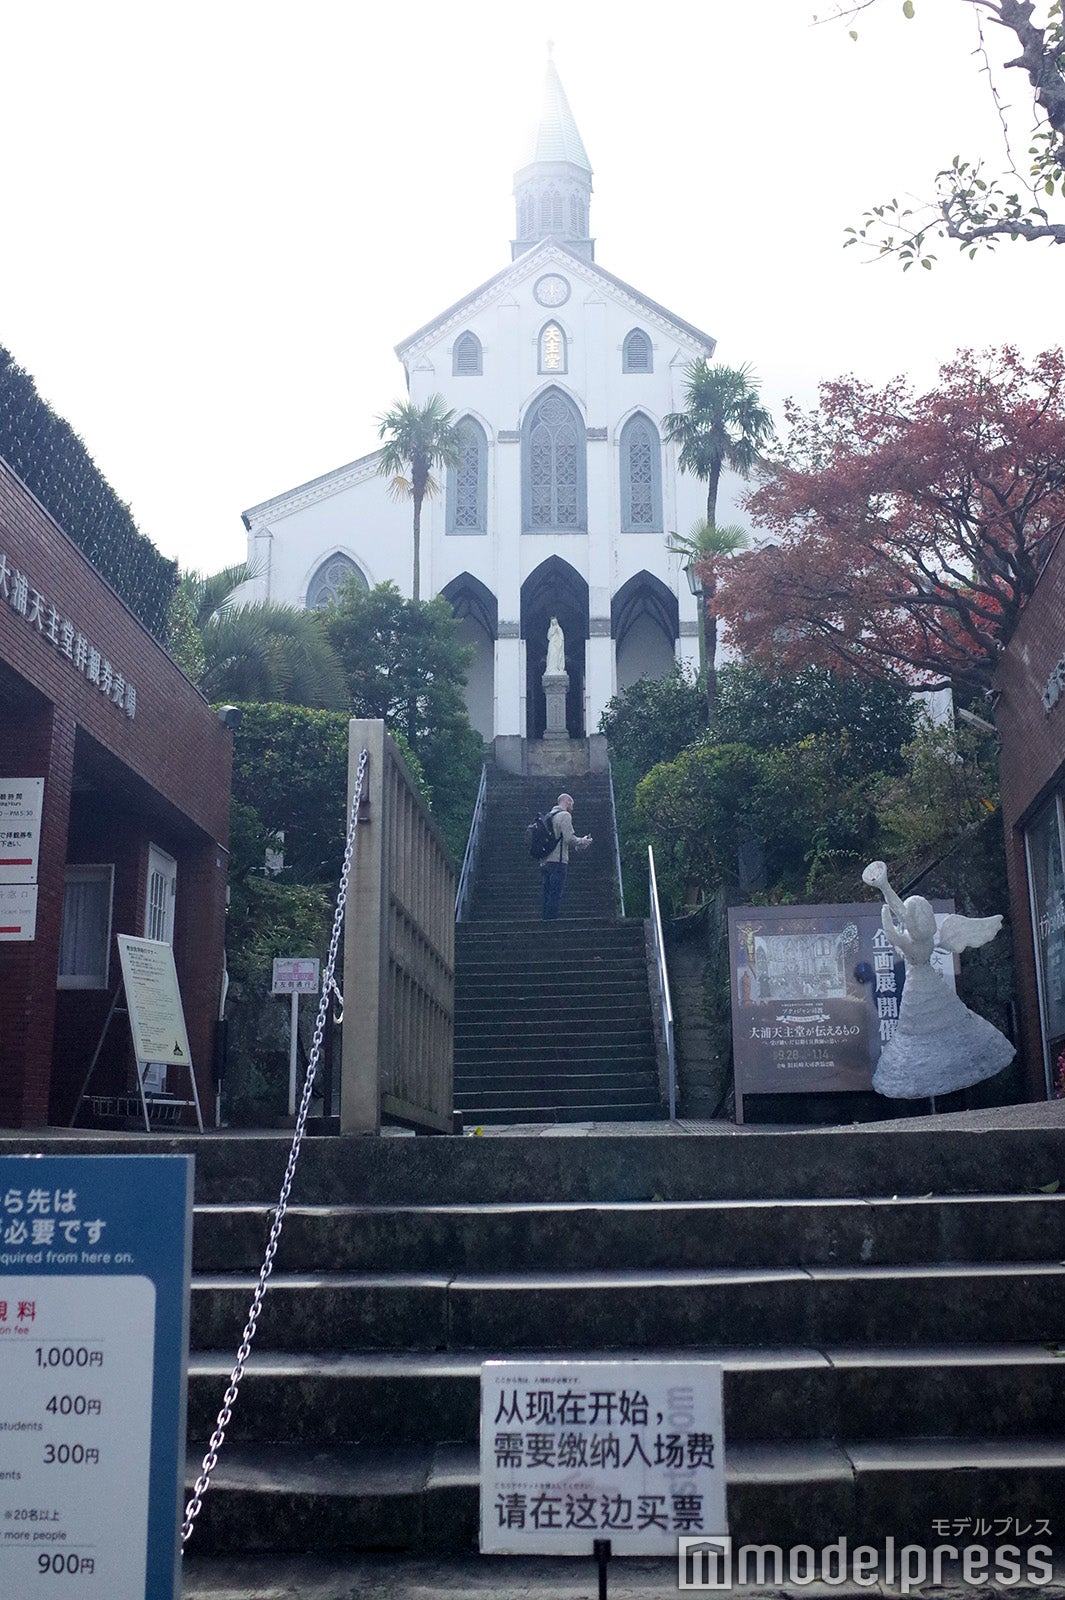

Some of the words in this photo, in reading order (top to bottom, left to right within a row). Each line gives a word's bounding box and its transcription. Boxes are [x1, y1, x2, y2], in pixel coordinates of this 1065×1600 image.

[872, 928, 899, 1054] 企画展開催
[749, 1025, 860, 1039] 大浦天主堂が伝えるもの
[4, 1188, 77, 1214] ら先は
[0, 1218, 107, 1245] 必要です
[46, 1251, 77, 1263] from
[81, 1252, 110, 1263] here
[114, 1254, 135, 1263] on.
[14, 1325, 29, 1335] fee
[35, 1347, 103, 1368] 1,000円
[46, 1395, 101, 1415] 400円
[494, 1389, 664, 1426] 从现在开始，
[0, 1421, 43, 1431] students
[43, 1444, 99, 1464] 300円
[494, 1432, 715, 1469] 需要缴纳入场费
[494, 1493, 704, 1530] 请在这边买票
[4, 1531, 30, 1540] more
[33, 1531, 67, 1541] people
[38, 1554, 95, 1574] 900円
